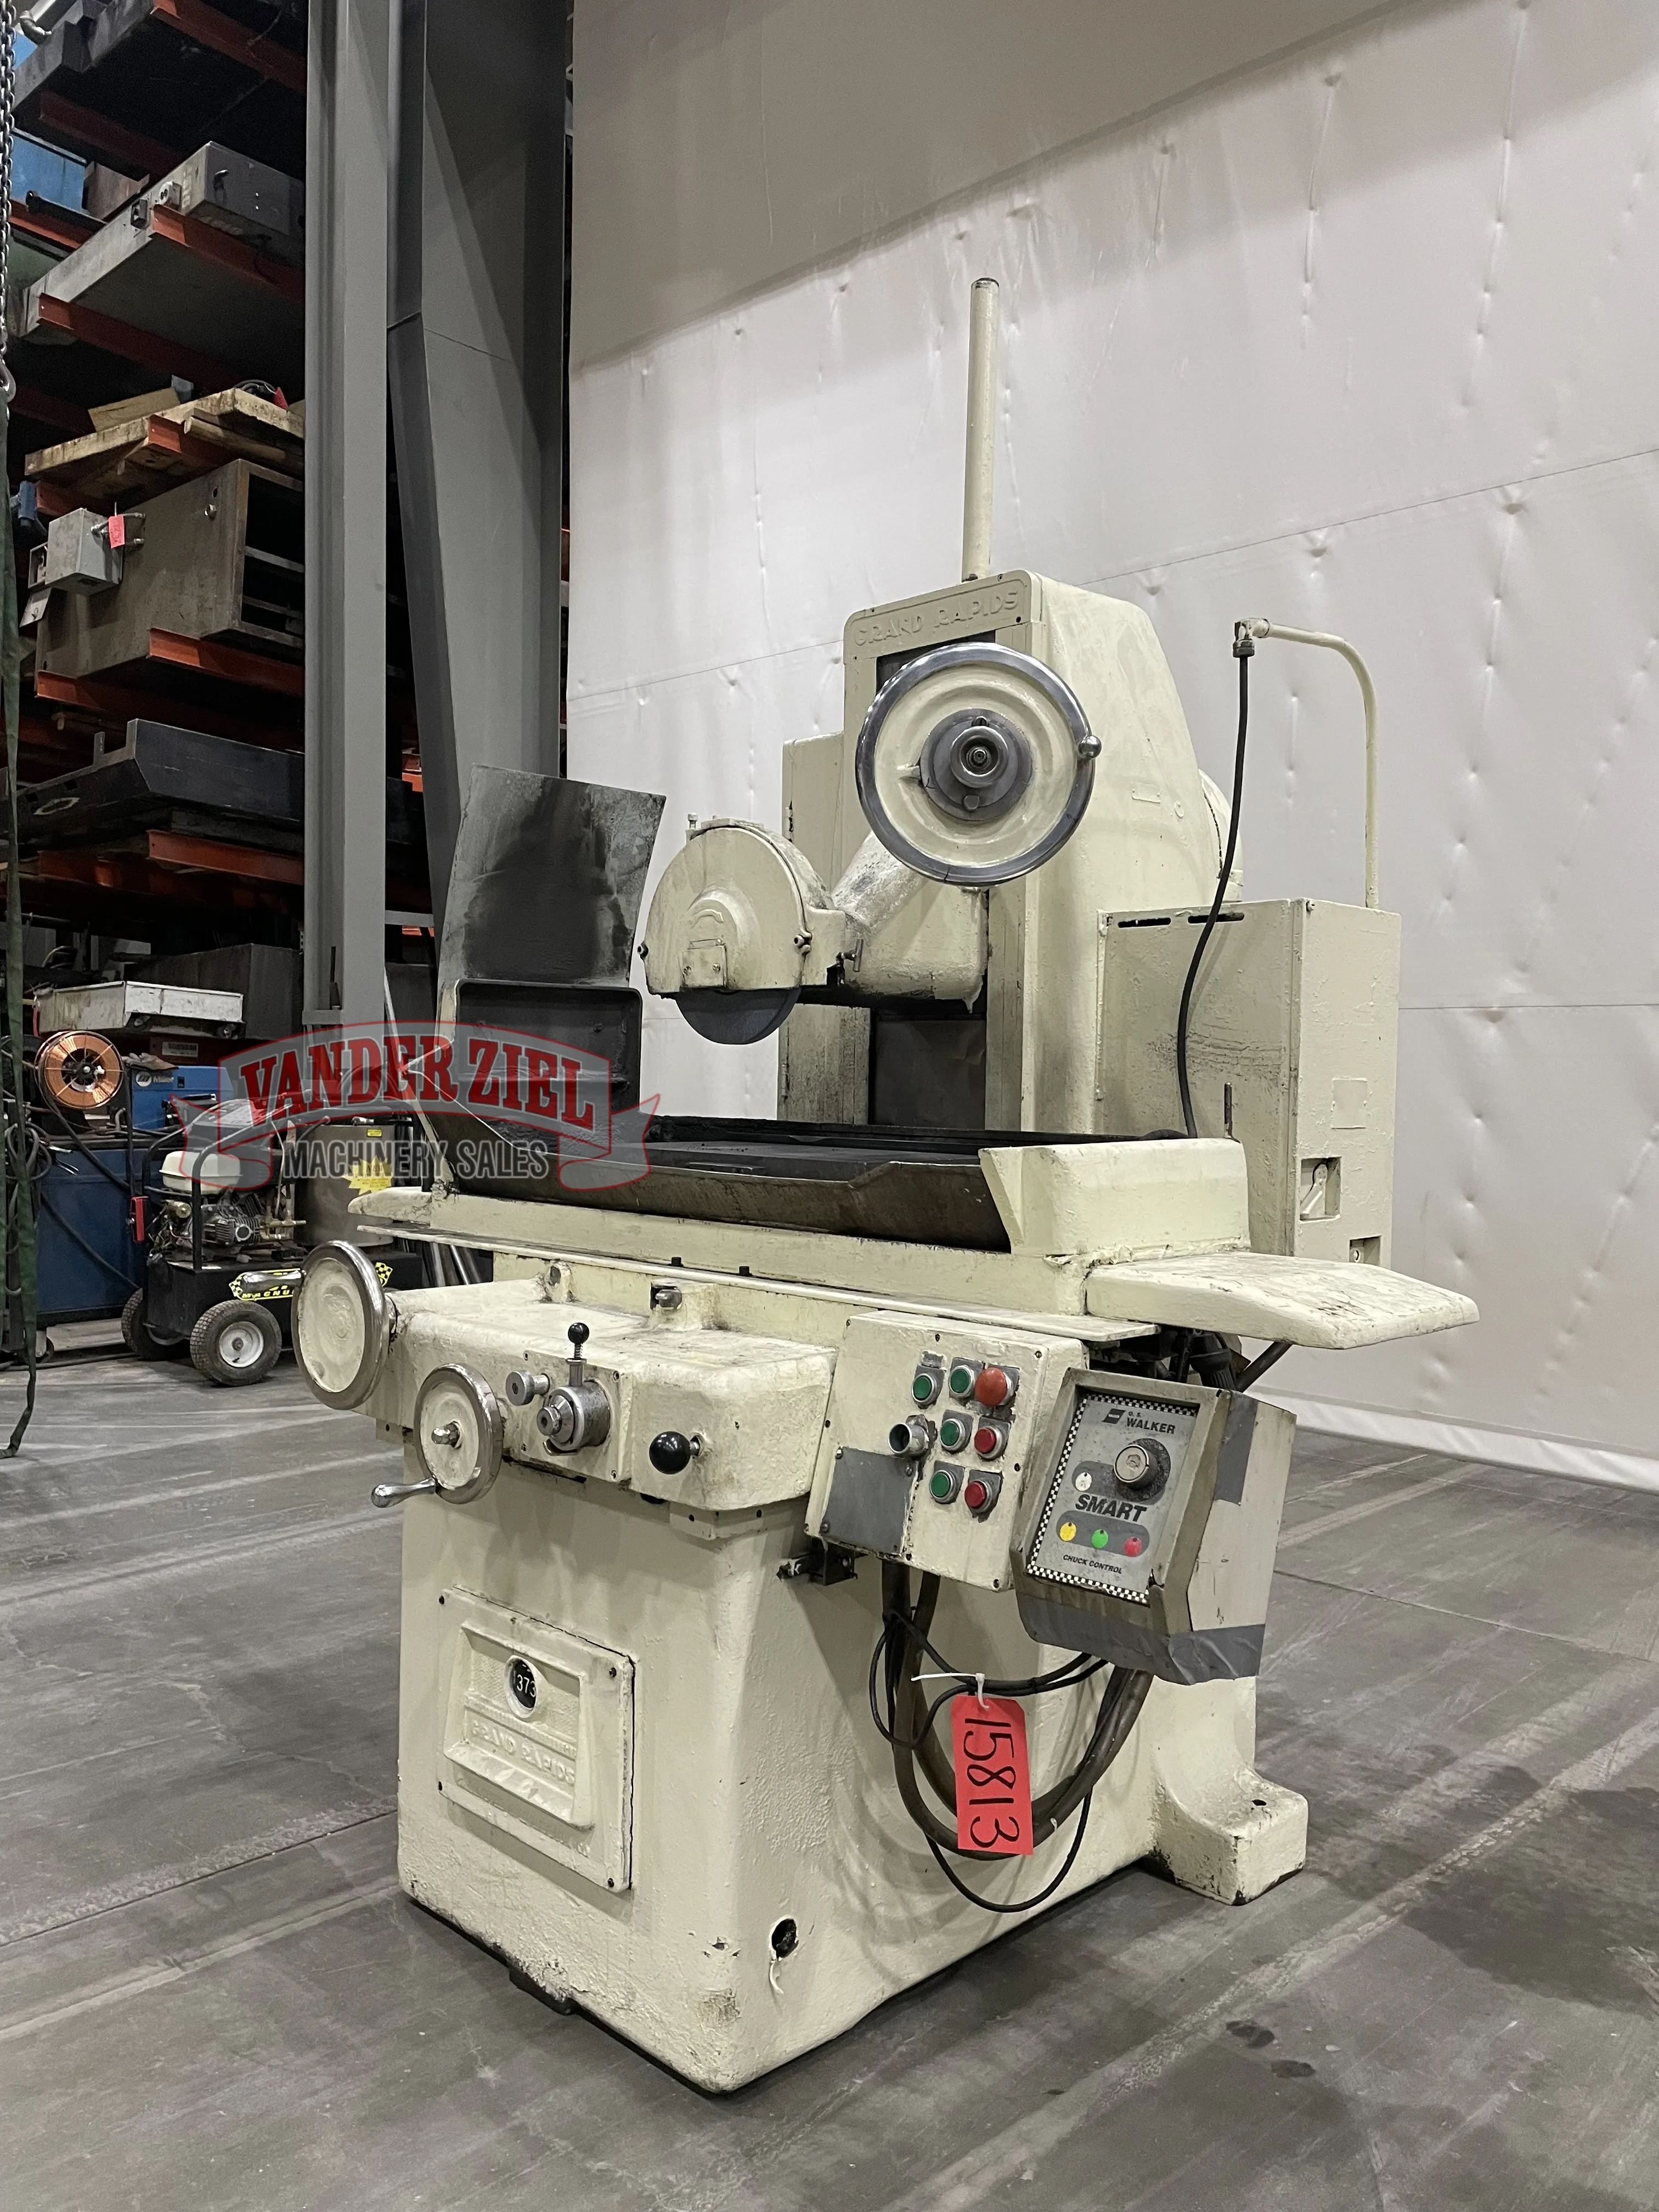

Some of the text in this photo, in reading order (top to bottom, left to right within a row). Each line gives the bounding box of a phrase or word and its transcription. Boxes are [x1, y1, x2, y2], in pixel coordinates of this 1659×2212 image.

[854, 591, 1018, 646] GRAND RAPIDS
[1127, 1417, 1176, 1434] WALKER
[1075, 1494, 1147, 1522] SMART
[1063, 1554, 1122, 1574] CHUCK CONTROL
[963, 1718, 1019, 1848] 15813
